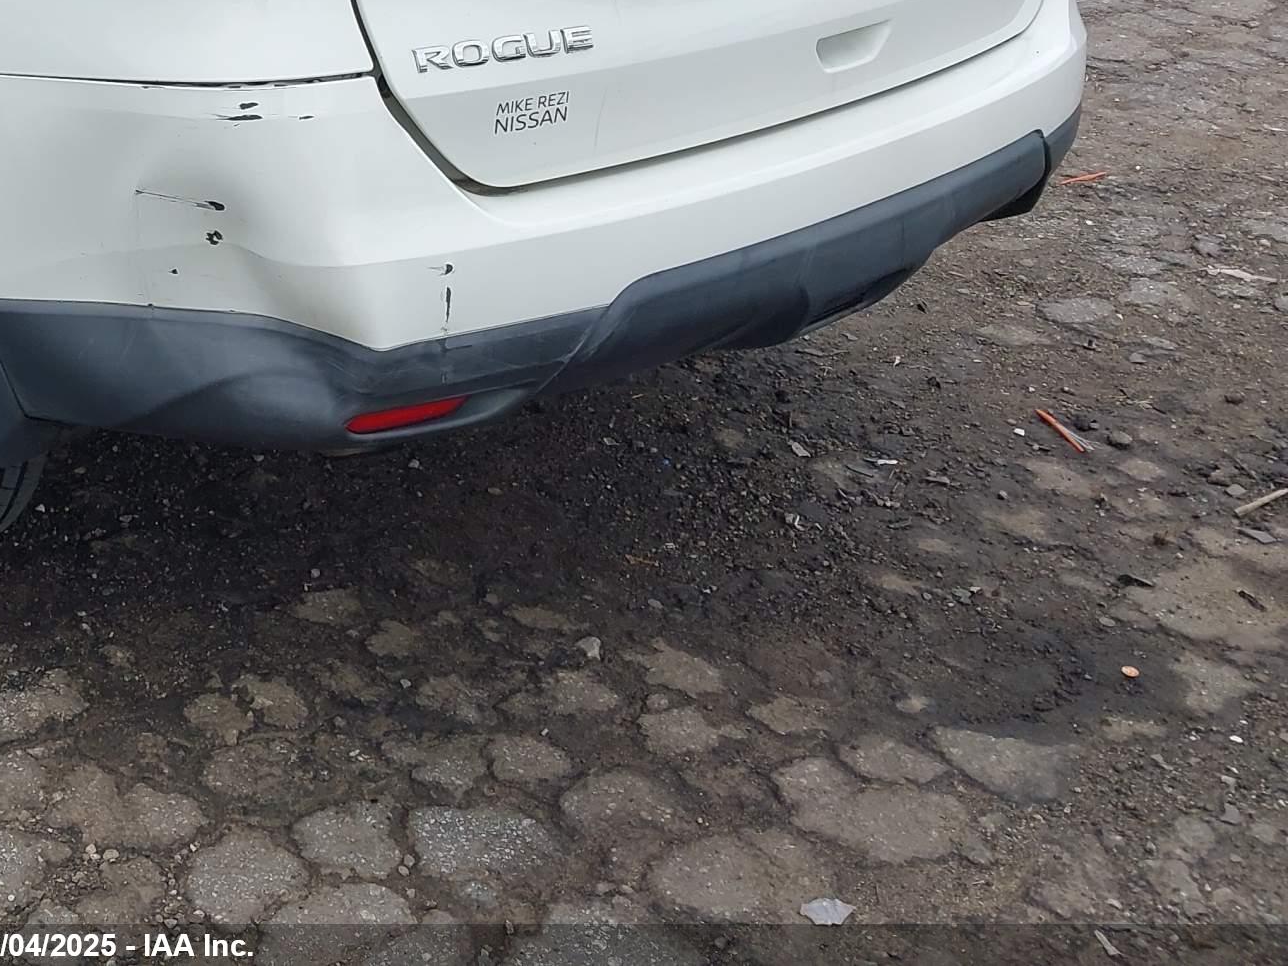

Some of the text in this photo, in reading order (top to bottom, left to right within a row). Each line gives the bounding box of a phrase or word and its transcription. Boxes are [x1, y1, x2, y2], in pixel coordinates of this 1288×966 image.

[412, 25, 594, 73] ROGUE
[496, 90, 570, 116] MIKE REZI
[494, 105, 568, 135] NISSAN
